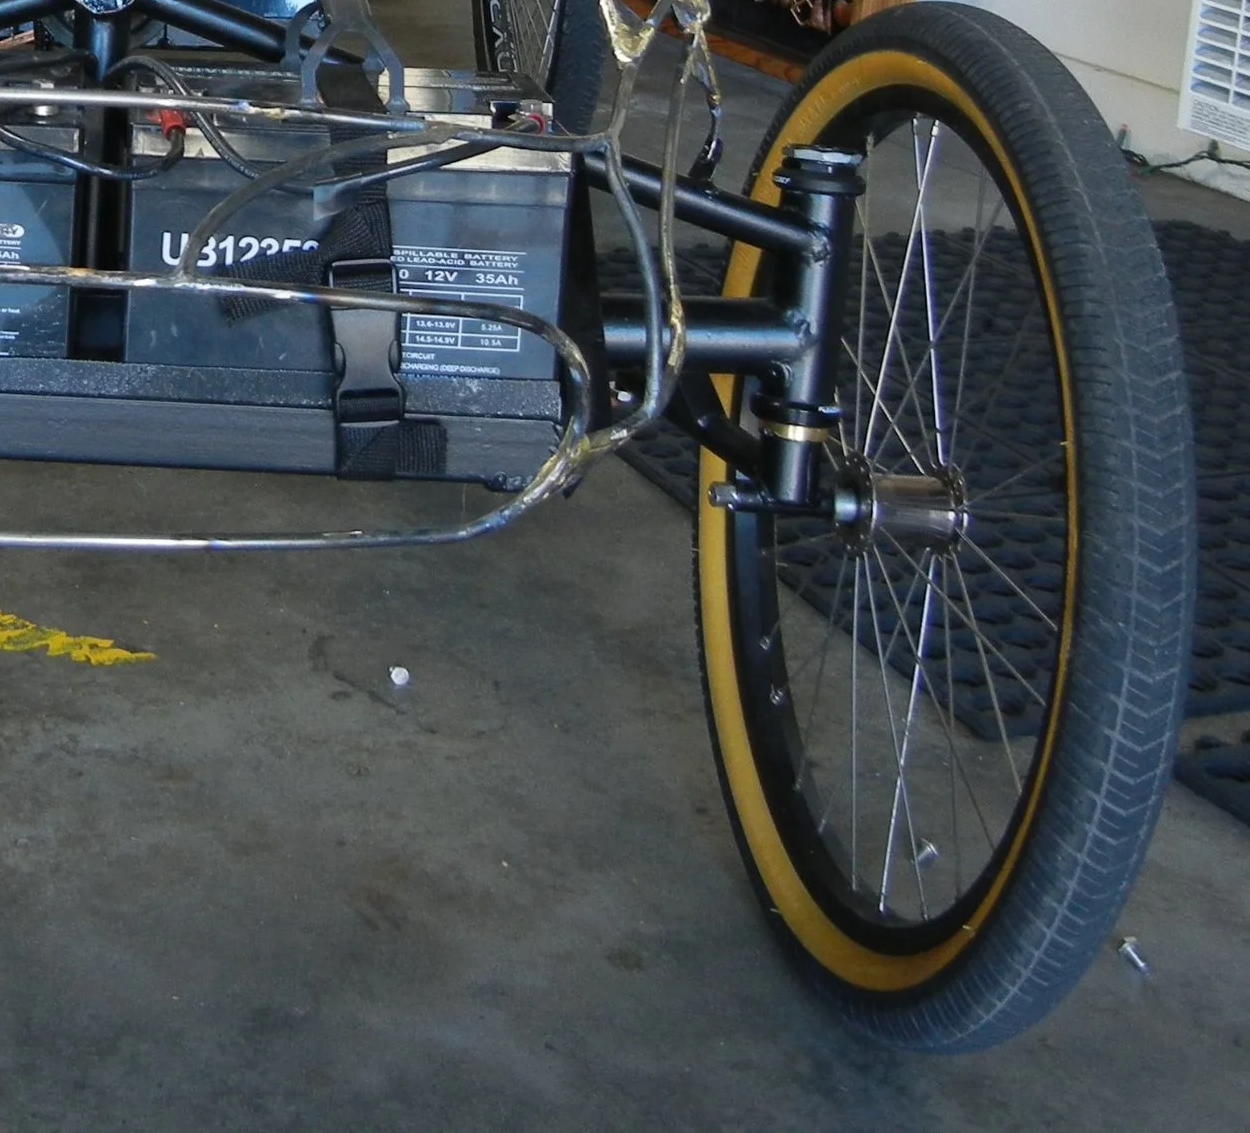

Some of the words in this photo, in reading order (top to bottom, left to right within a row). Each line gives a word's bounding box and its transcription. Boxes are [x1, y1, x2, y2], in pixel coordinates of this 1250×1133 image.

[407, 256, 465, 266] LEAD-ACID
[469, 260, 519, 269] BATTERY
[464, 252, 519, 262] BATTERY
[424, 270, 458, 282] 12V
[475, 272, 519, 286] 35Ah
